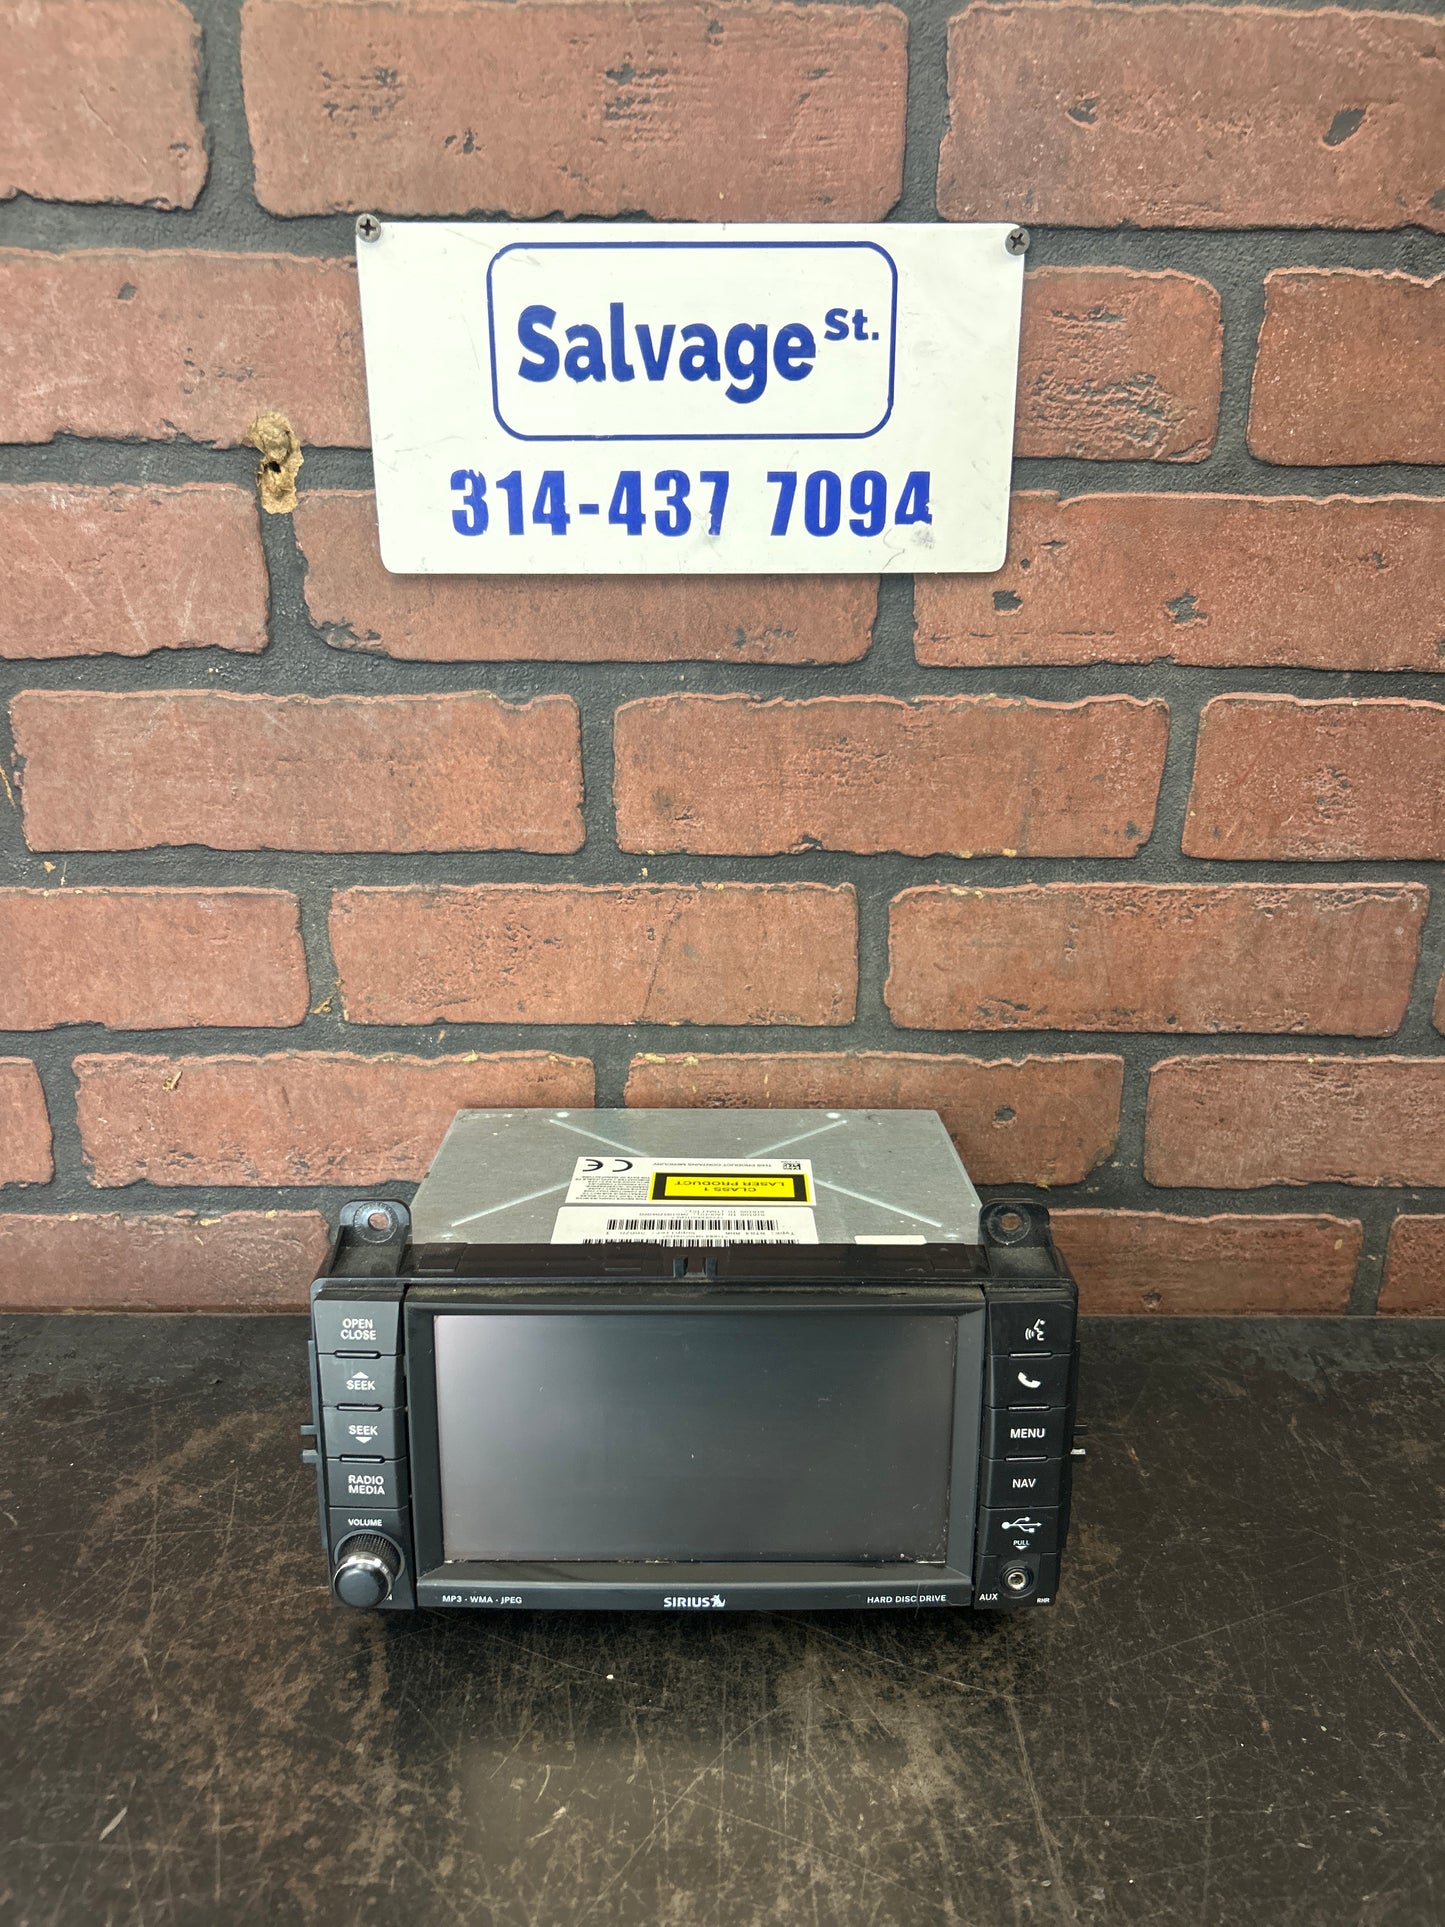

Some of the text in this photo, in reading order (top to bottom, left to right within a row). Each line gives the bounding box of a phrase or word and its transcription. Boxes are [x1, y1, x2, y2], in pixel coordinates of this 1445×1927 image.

[517, 302, 880, 404] Salvage St.
[450, 469, 933, 537] 314-437 7094
[342, 1318, 374, 1329] OPEN
[340, 1329, 377, 1341] CLOSE
[346, 1379, 376, 1391] SEEK
[348, 1424, 378, 1436] SEEK
[1010, 1428, 1046, 1439] MENU
[348, 1474, 384, 1486] RADIO
[1012, 1478, 1036, 1488] NAV
[348, 1485, 386, 1495] MEDIA
[347, 1518, 383, 1527] VOLUME
[442, 1595, 523, 1604] MP3 WMA JPEG
[663, 1596, 710, 1608] SIRIUS
[867, 1594, 947, 1604] HARD DISC DRIVE
[979, 1593, 998, 1601] AUX
